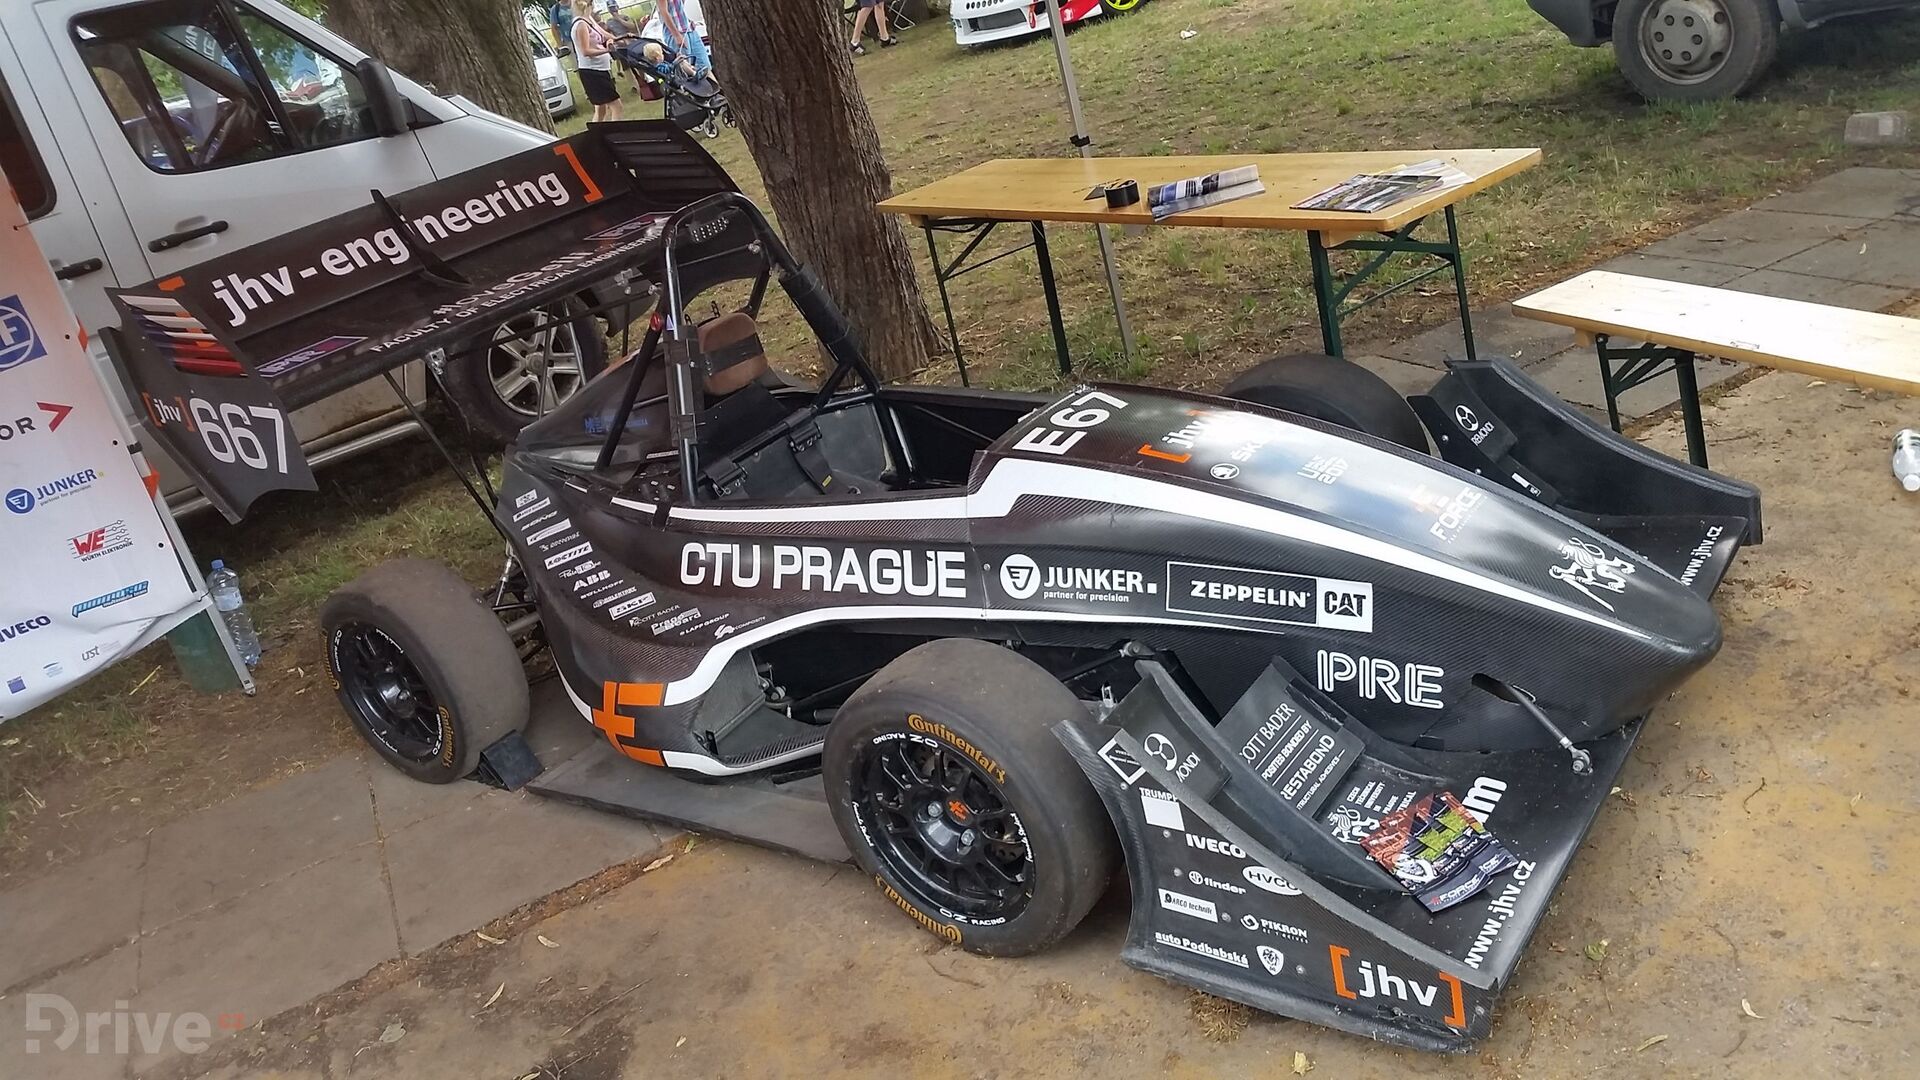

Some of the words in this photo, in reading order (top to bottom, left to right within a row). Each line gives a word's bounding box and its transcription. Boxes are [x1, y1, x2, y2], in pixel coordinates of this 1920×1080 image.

[212, 172, 570, 327] jhv-engneering
[370, 317, 452, 352] FACULTY
[456, 306, 479, 319] OF
[481, 267, 579, 308] ELECTRICAL
[189, 398, 288, 474] 667
[1471, 420, 1495, 447] REMONDI
[37, 468, 97, 500] JUNKER
[1430, 486, 1482, 541] FORCE
[72, 528, 106, 555] WE
[547, 545, 590, 567] LOCTITE
[680, 542, 760, 589] CTU
[772, 544, 967, 598] PRAGUE
[573, 569, 611, 592] ABB
[1043, 565, 1144, 593] JUNKER
[616, 596, 649, 613] SKF
[1043, 591, 1074, 602] partner
[1075, 592, 1088, 602] for
[1089, 593, 1130, 604] precision
[1190, 580, 1306, 608] ZEPPELIN
[1324, 590, 1367, 618] CAT
[1316, 649, 1445, 710] PRE
[873, 733, 906, 745] RACING
[908, 713, 998, 776] Continental
[909, 733, 939, 748] OZ
[1239, 733, 1266, 764] OTT
[1259, 703, 1295, 741] BADER
[1281, 728, 1305, 758] BONDED
[1300, 720, 1313, 735] BY
[1319, 755, 1340, 783] ADHESIVES
[1346, 786, 1361, 802] CZECH
[1355, 781, 1376, 806] TECHNICAL
[1364, 781, 1386, 809] UNIVERSITY
[1396, 791, 1417, 813] TRICAL
[1186, 833, 1247, 859] IVECO
[1204, 877, 1247, 895] finder
[939, 908, 968, 924] OZ
[971, 916, 1006, 927] RACING
[1260, 918, 1308, 939] PIKRON
[1464, 860, 1537, 970] www.jhv.cz
[1155, 931, 1181, 946] auto
[1182, 938, 1249, 966] Podbabská
